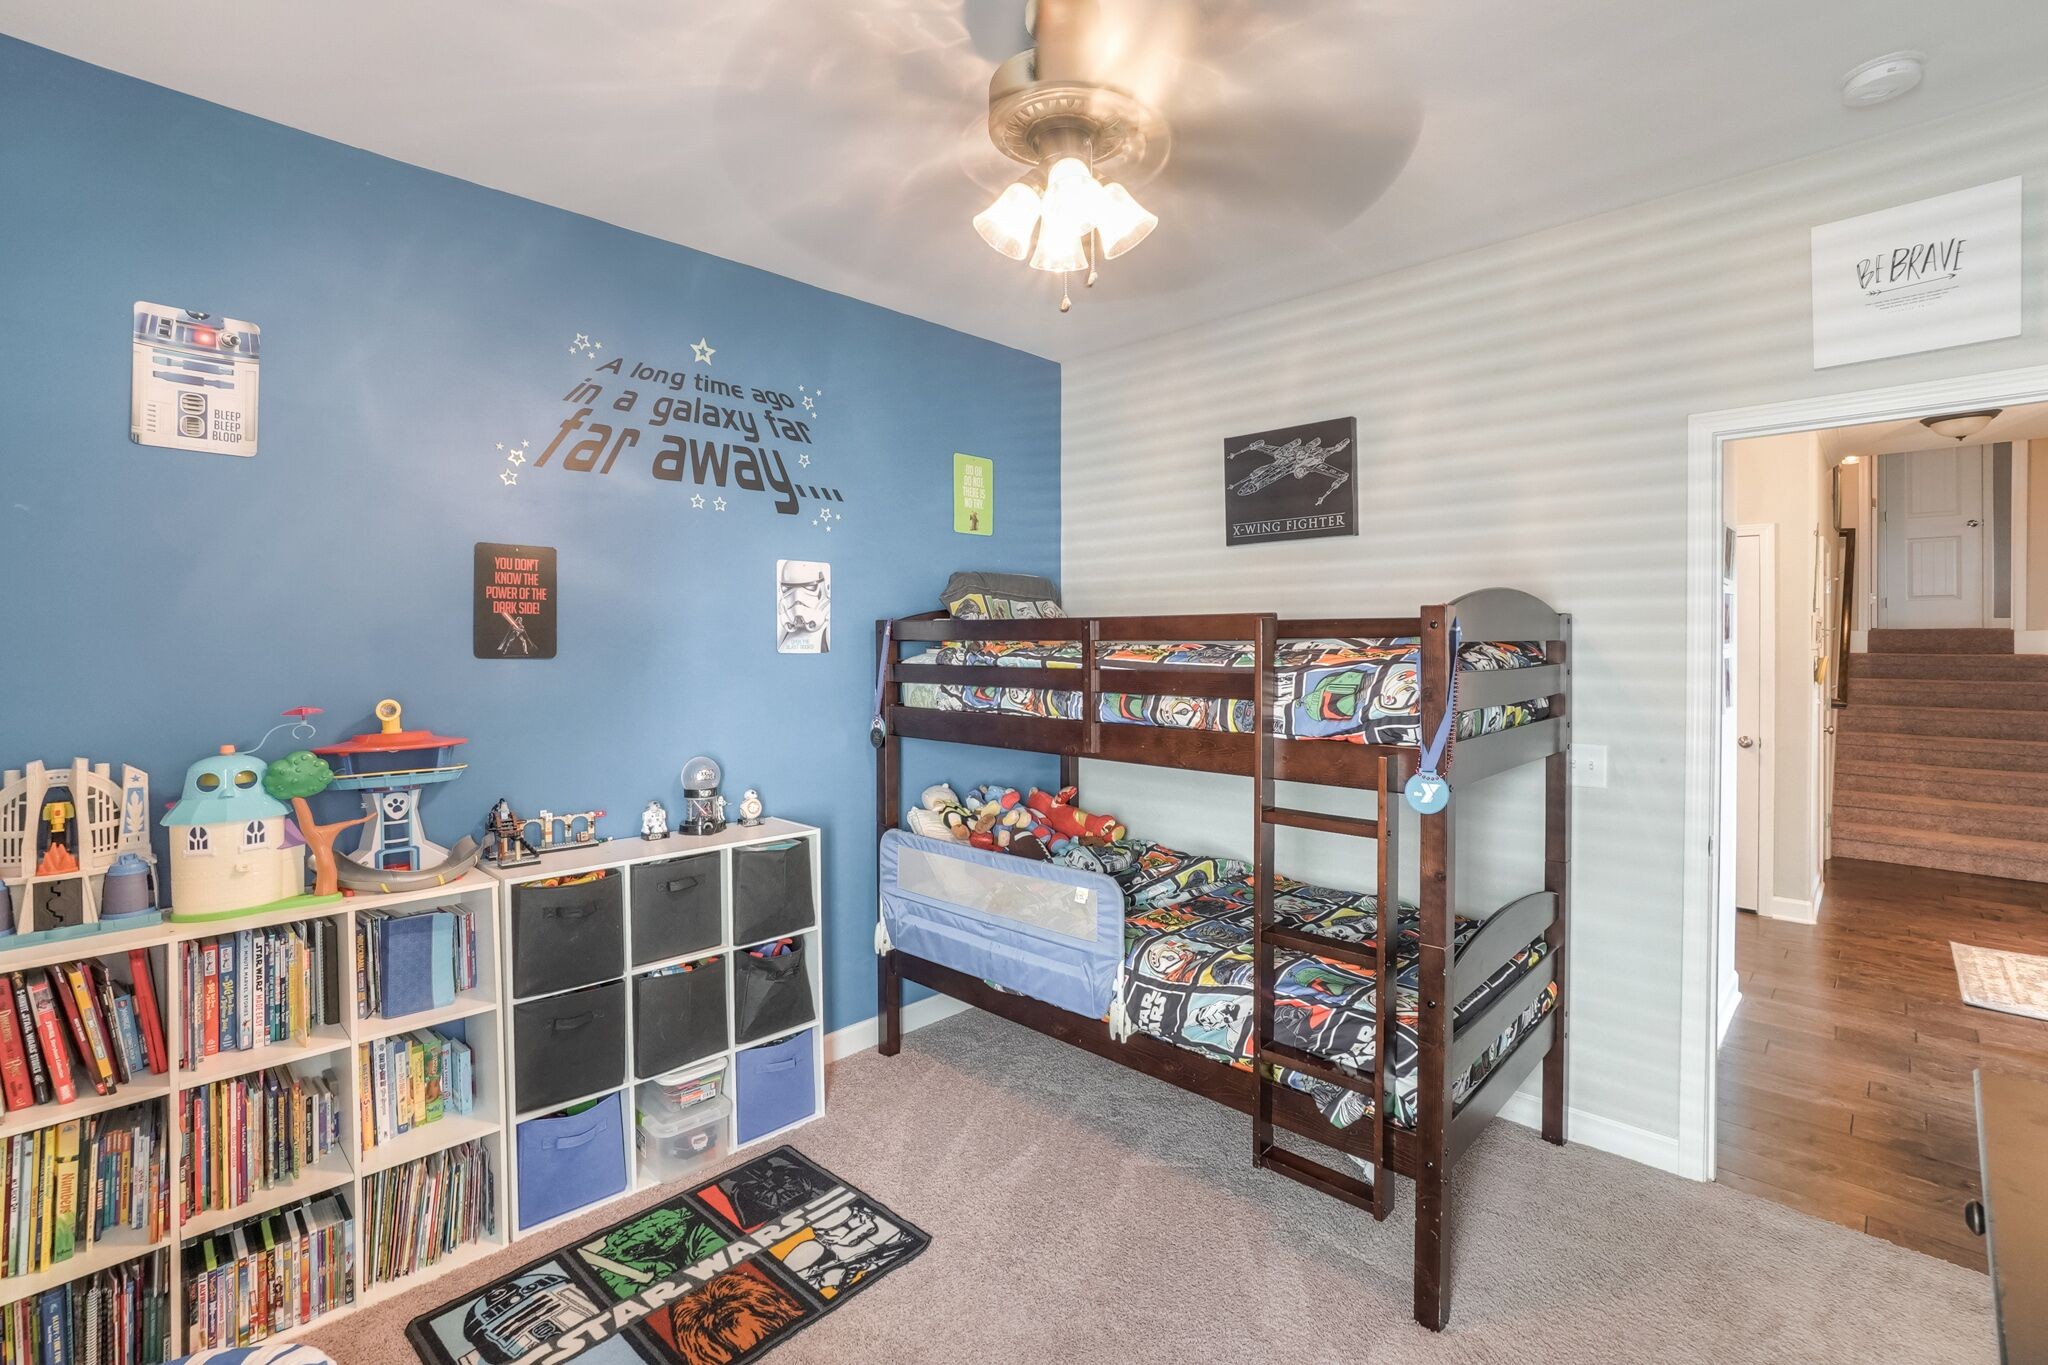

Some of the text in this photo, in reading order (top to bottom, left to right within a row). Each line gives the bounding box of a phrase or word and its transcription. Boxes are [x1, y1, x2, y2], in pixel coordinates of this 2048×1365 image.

[1856, 238, 1967, 289] BE BRAVE
[595, 357, 795, 411] A long time ago
[214, 409, 241, 422] BLEEP
[562, 377, 812, 444] in a galaxy far
[213, 420, 241, 432] BLEEP
[212, 431, 242, 443] BLOOP
[533, 407, 641, 475] far
[1233, 515, 1345, 536] X-WING FIGHTER
[495, 557, 539, 571] YOU DON'T
[495, 572, 539, 586] KNOW THE
[486, 586, 547, 600] POWER OF THE
[493, 601, 540, 614] DARK SIDE!
[222, 980, 234, 995] BIG
[255, 942, 263, 1027] STAR WARS MADE EASY
[21, 1013, 33, 1034] STAR
[26, 1033, 37, 1054] WARS
[29, 1054, 41, 1074] STORIES
[59, 1172, 75, 1214] Numbers
[540, 1208, 810, 1365] STAR WARS
